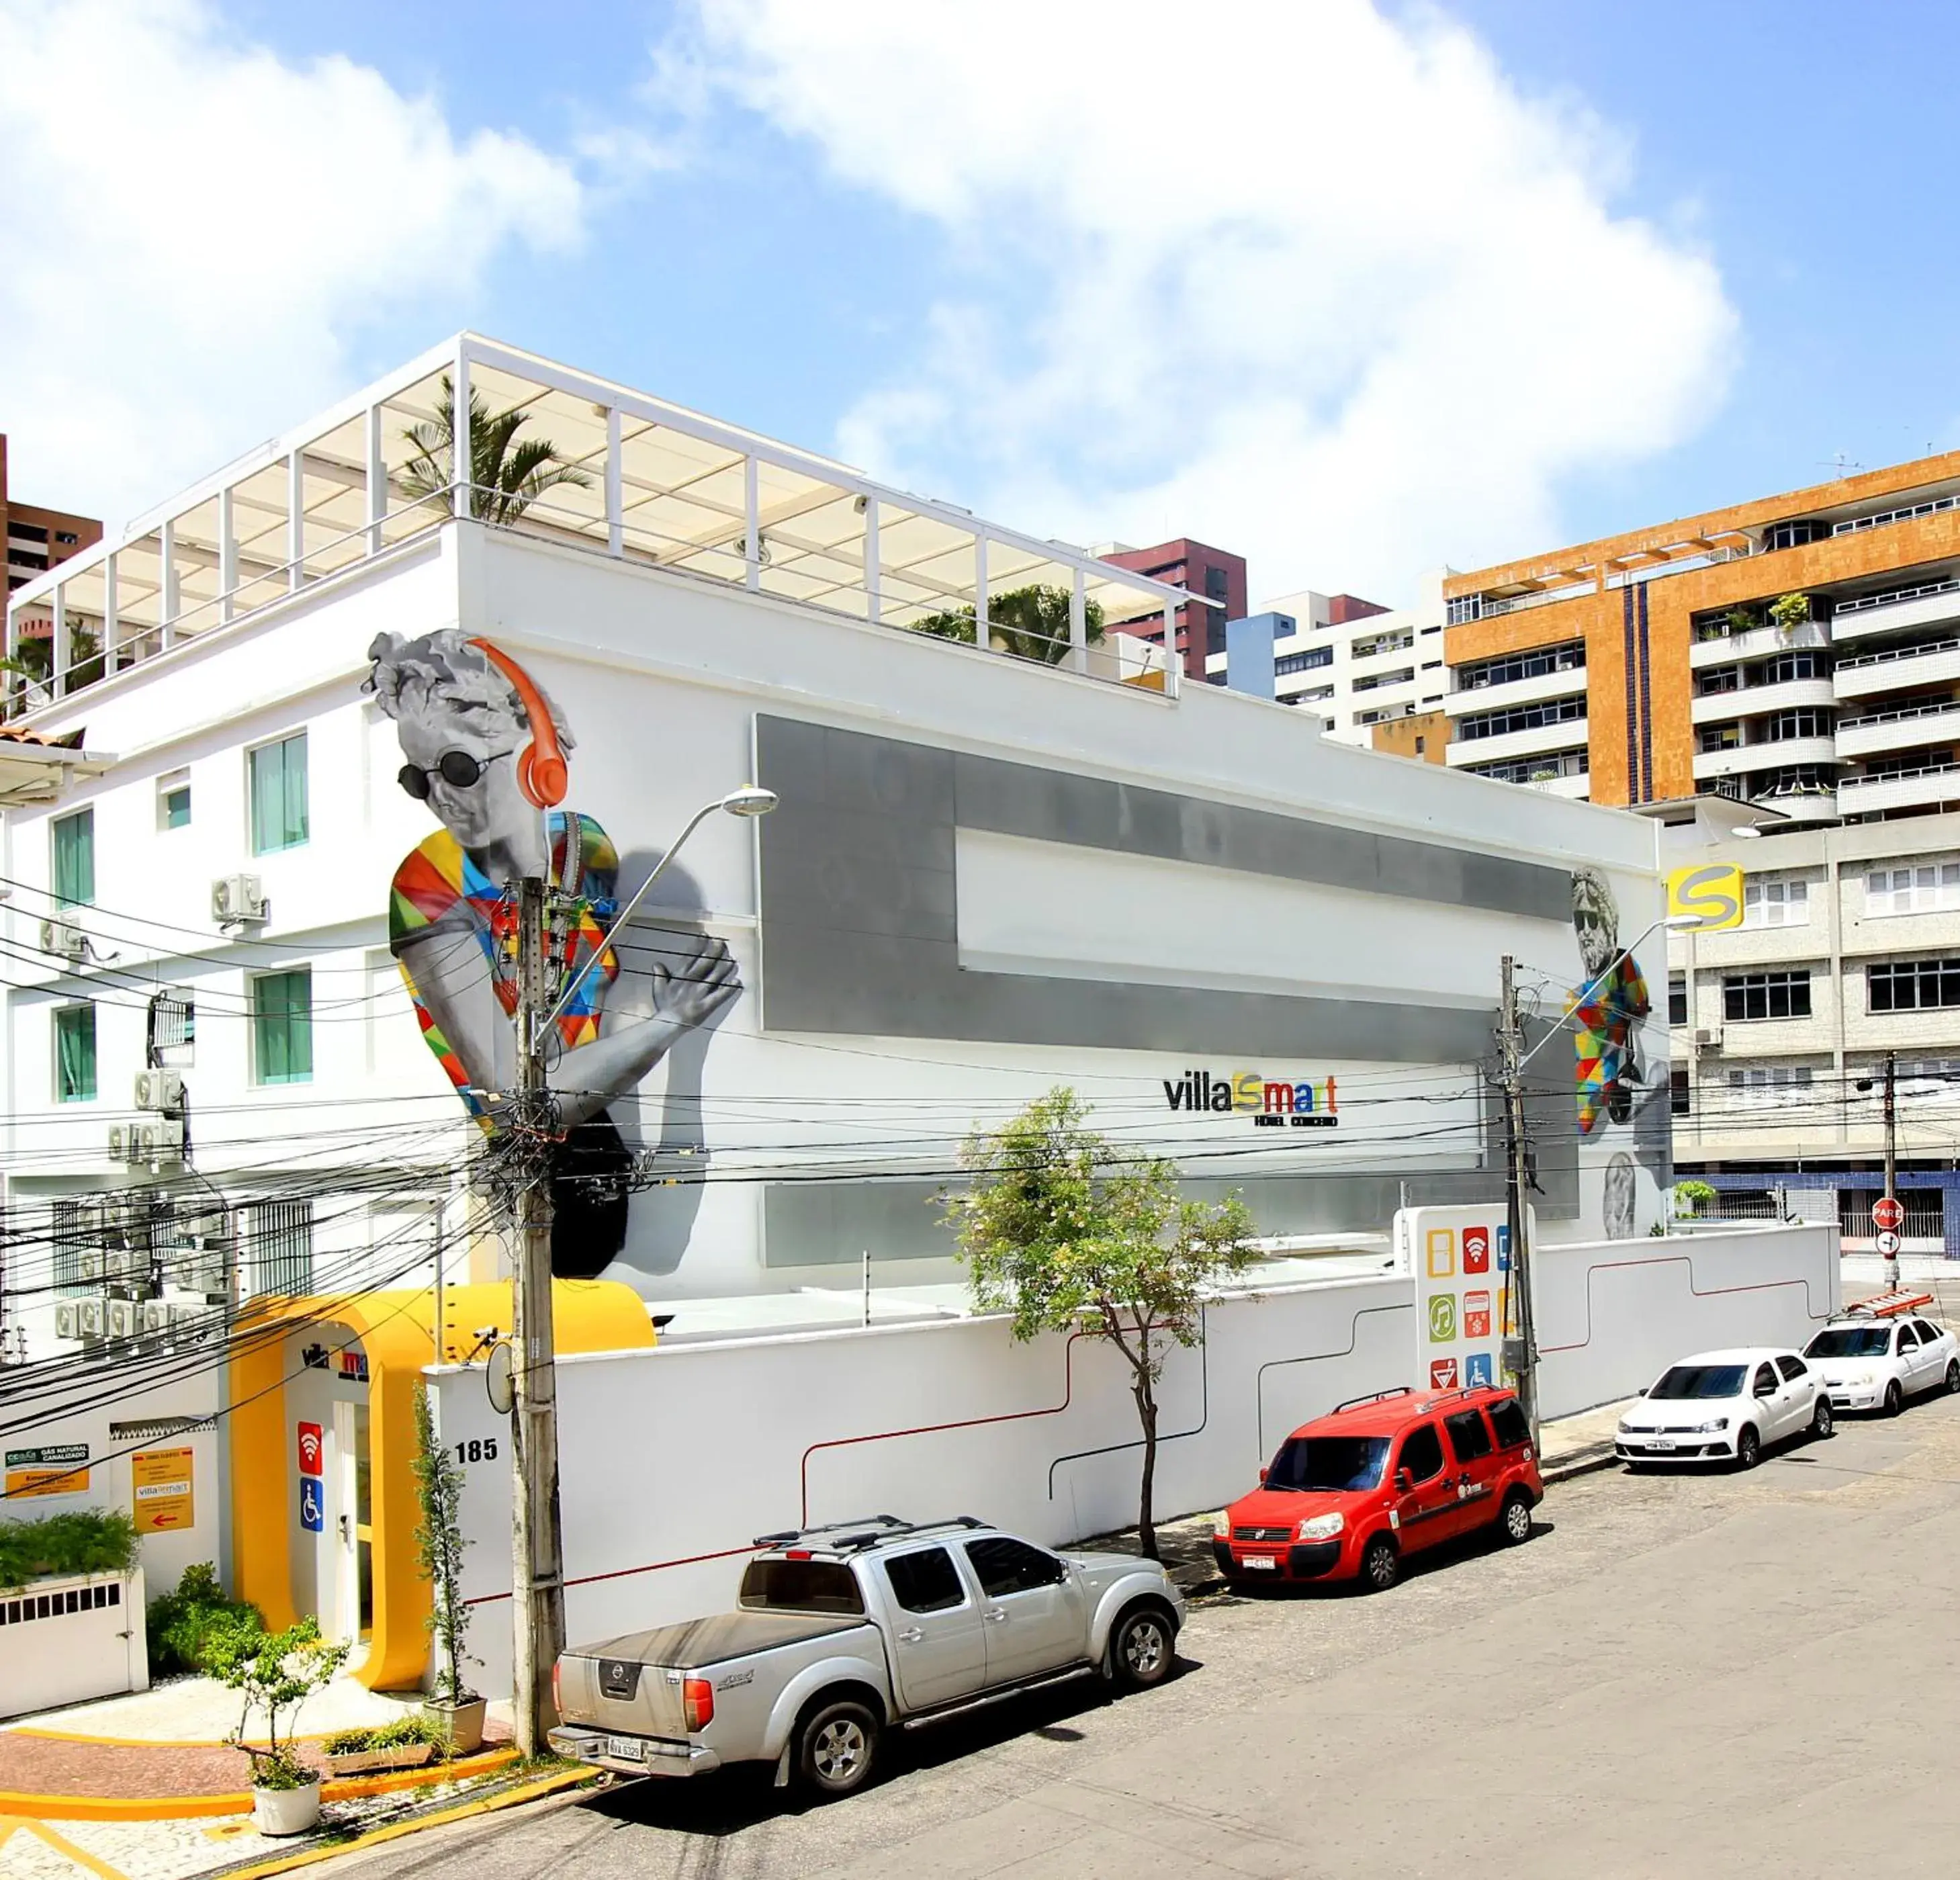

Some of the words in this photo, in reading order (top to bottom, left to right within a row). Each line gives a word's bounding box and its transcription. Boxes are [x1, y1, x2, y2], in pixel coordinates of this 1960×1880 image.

[1675, 865, 1737, 927] S
[1163, 1071, 1338, 1114] villaSmart
[1874, 1208, 1902, 1218] PARE
[455, 1438, 497, 1464] 185
